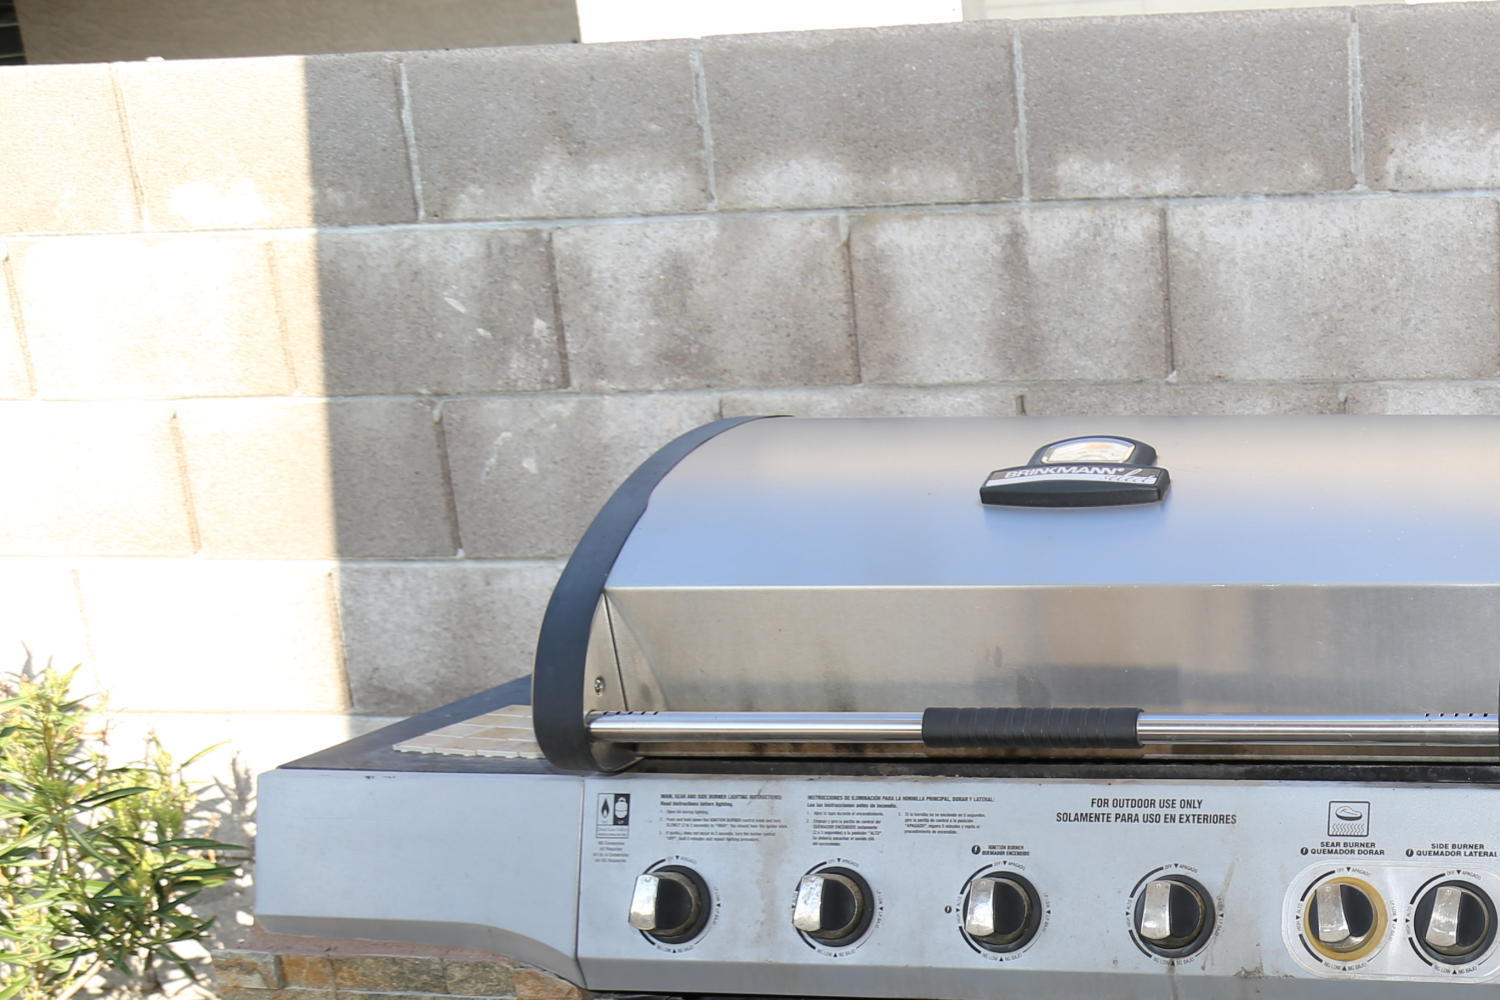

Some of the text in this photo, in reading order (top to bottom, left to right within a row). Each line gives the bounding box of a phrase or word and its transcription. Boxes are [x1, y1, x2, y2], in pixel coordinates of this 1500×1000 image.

[1004, 466, 1116, 479] BRINKMANN
[1091, 798, 1203, 809] FOR OUTDOOR USE ONLY
[1056, 812, 1237, 824] SOLAMENTE PARA USO EN EXTERIORES
[1344, 841, 1375, 849] BURNER
[1310, 848, 1354, 856] QUEMADOR
[1464, 850, 1498, 858] LATERAL
